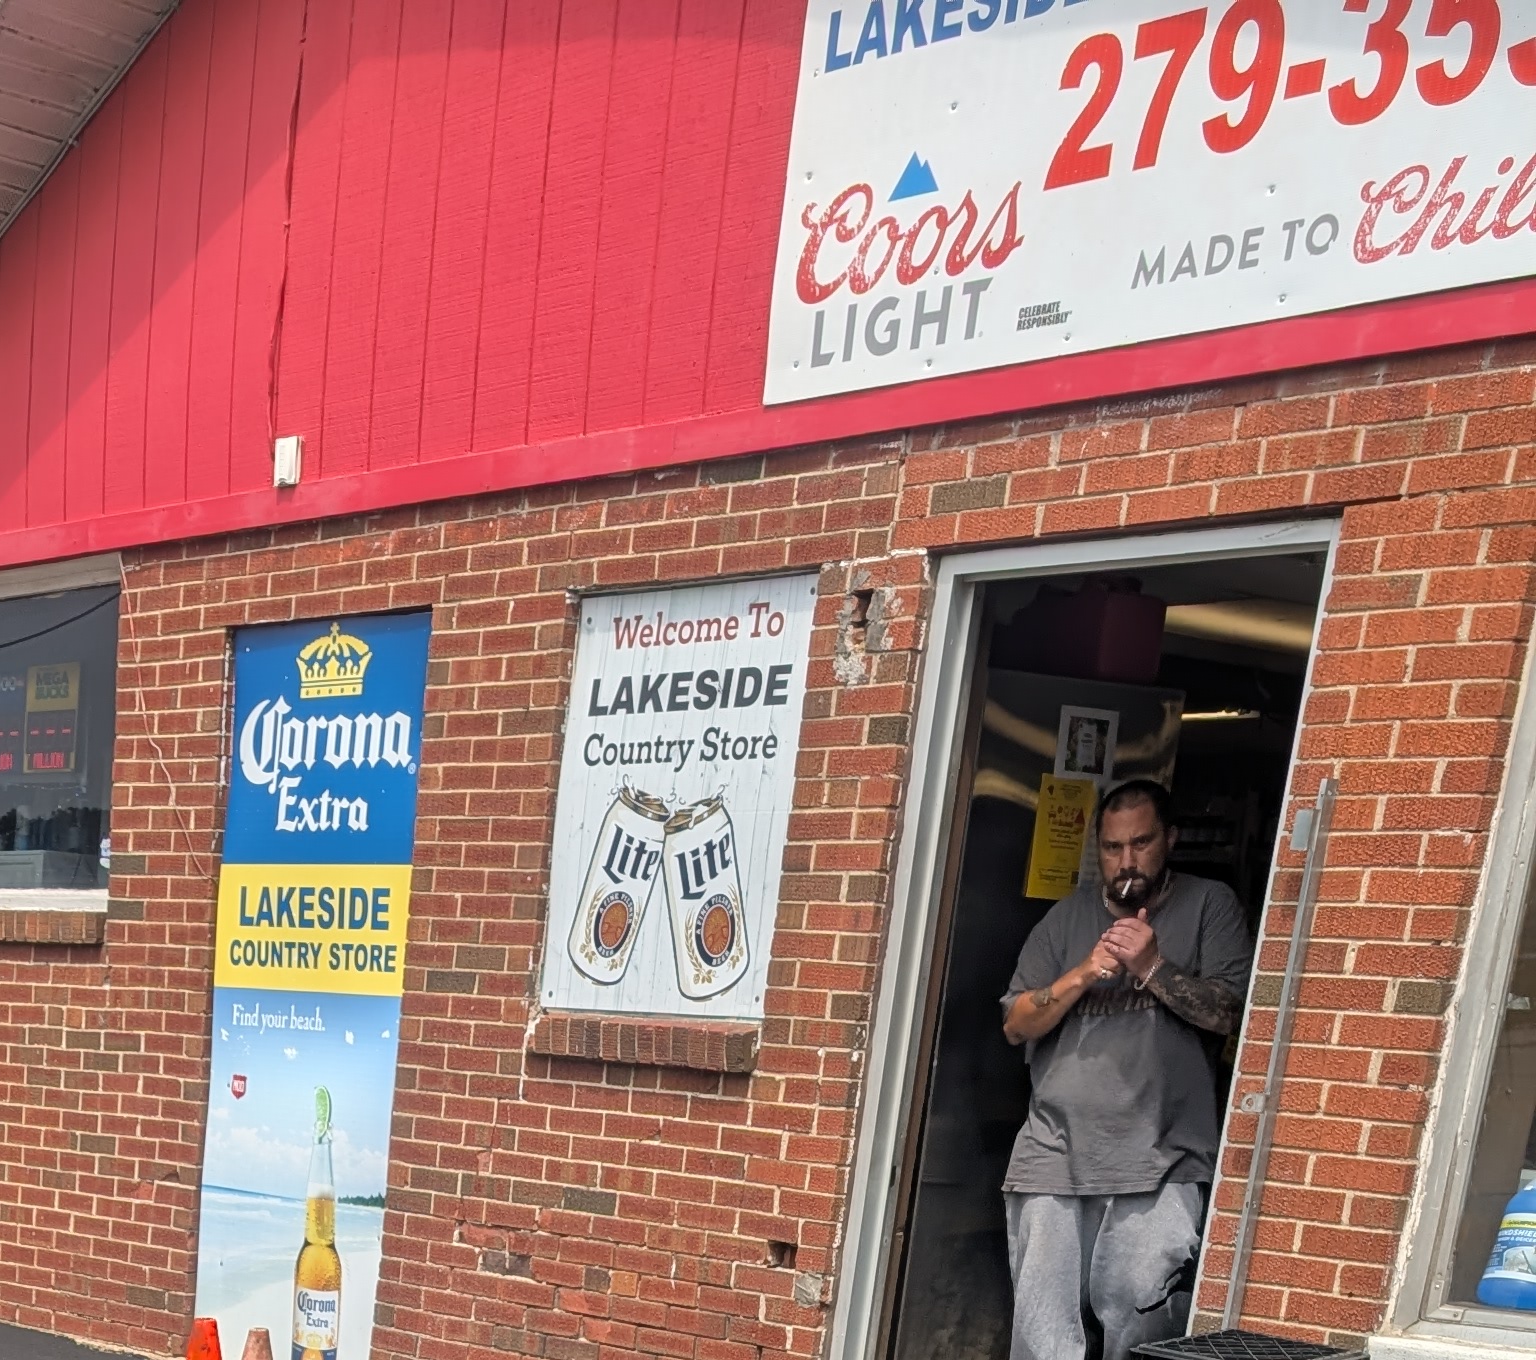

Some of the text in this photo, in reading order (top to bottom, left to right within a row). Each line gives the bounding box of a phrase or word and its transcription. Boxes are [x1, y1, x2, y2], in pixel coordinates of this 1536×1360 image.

[824, 0, 1090, 73] LAKES
[1043, 0, 1536, 191] 279-35
[795, 180, 1026, 304] Coors
[1130, 153, 1536, 290] MADE TO Chil
[810, 276, 994, 368] LIGHT
[1016, 311, 1070, 331] RESPONSIBLY
[1018, 300, 1062, 320] CELEBRATE
[613, 602, 785, 650] Welcome To
[587, 663, 794, 718] LAKESIDE
[239, 695, 413, 794] Corona
[583, 726, 779, 772] Country Store
[275, 776, 370, 832] Extra
[602, 823, 660, 885] Lite
[674, 832, 732, 900] Lite
[239, 885, 391, 931] LAKESIDE
[229, 939, 398, 973] COUNTRY STORE
[232, 1003, 326, 1034] Find your beach.
[297, 1290, 336, 1315] Corona
[306, 1312, 329, 1328] Extra
